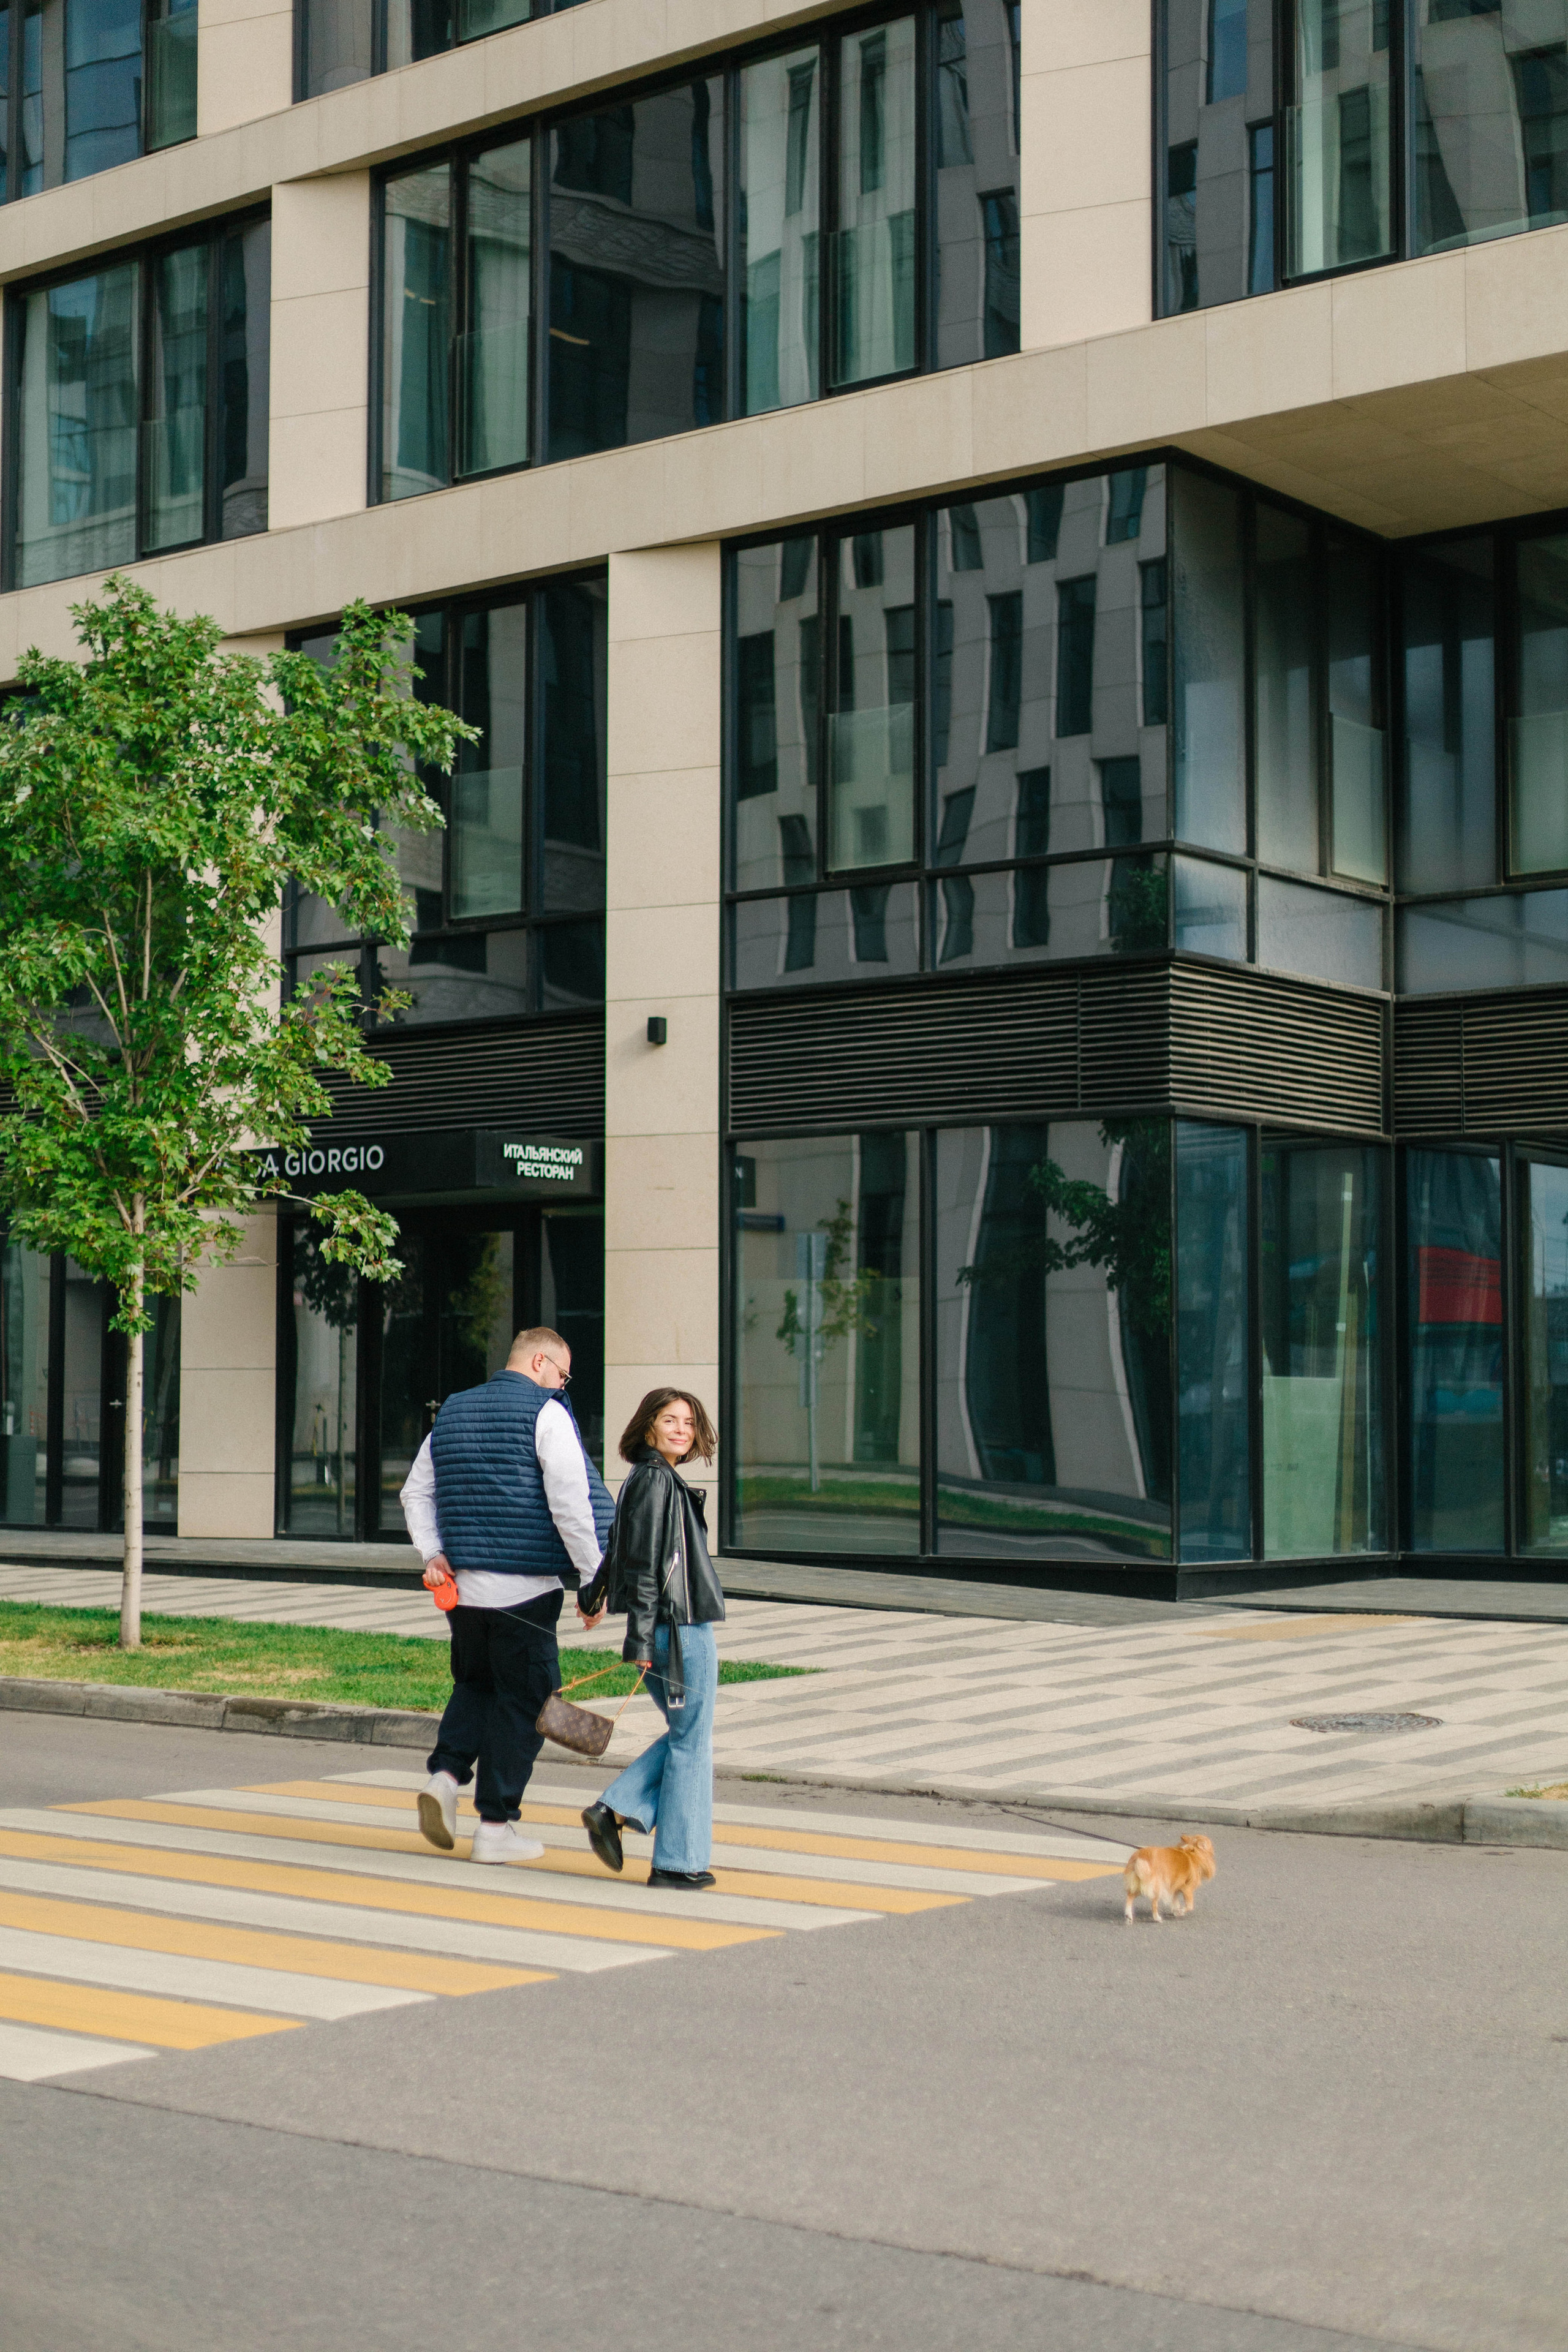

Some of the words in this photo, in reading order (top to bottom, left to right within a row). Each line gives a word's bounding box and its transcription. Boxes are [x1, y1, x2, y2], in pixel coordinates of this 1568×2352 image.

[284, 1145, 384, 1176] GIORGIO
[503, 1143, 582, 1164] ИТАЛЬЯНСКИЙ
[517, 1161, 574, 1180] РЕСТОРАН
